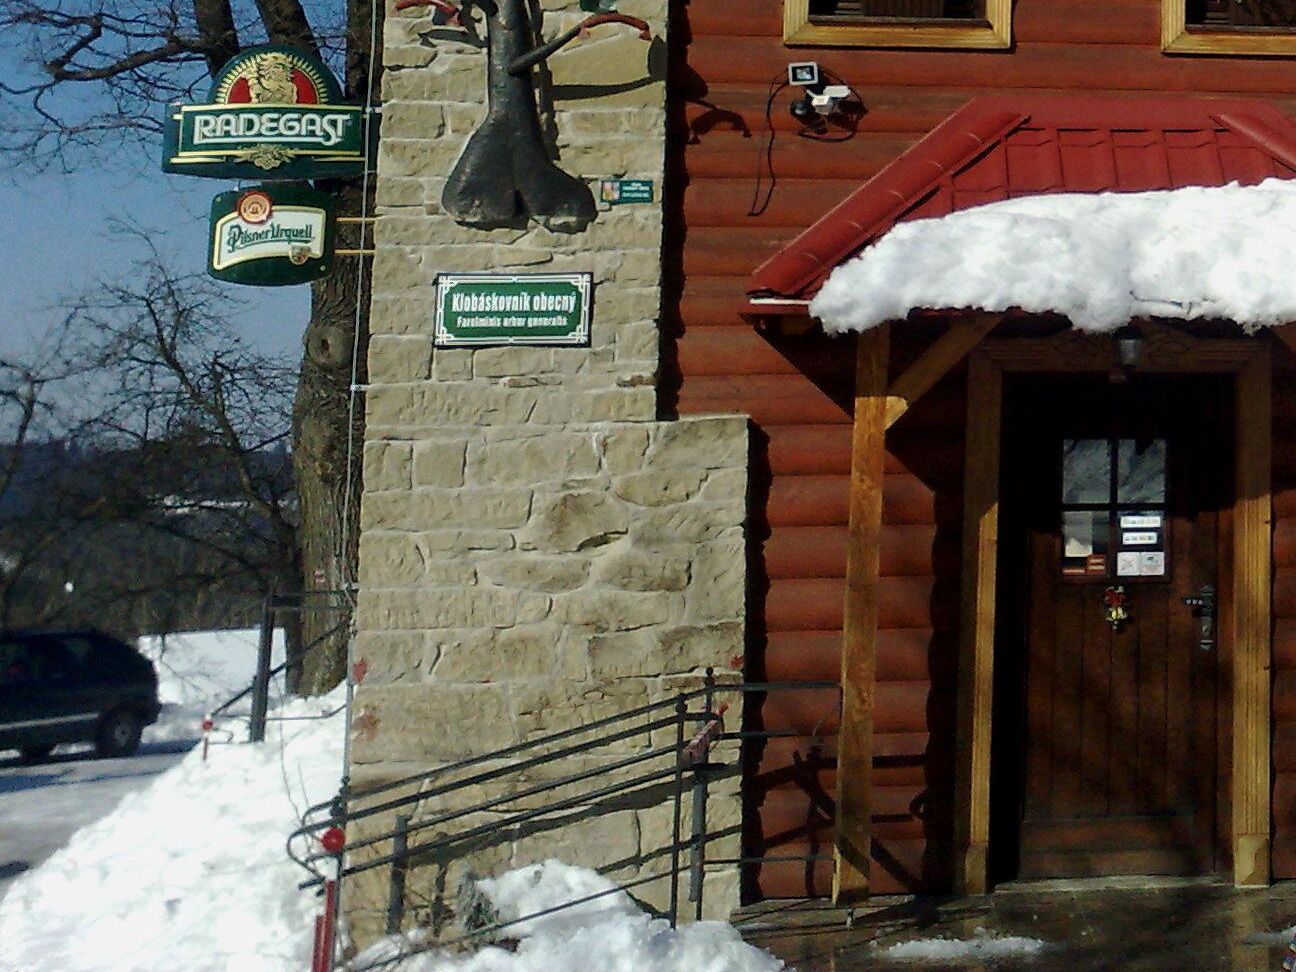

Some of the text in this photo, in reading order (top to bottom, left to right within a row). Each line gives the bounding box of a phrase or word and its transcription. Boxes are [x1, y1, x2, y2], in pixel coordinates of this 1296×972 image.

[193, 113, 351, 146] RADEGAST
[227, 221, 313, 253] Pilsner Urquell
[452, 291, 577, 313] Klobáskovník obecný
